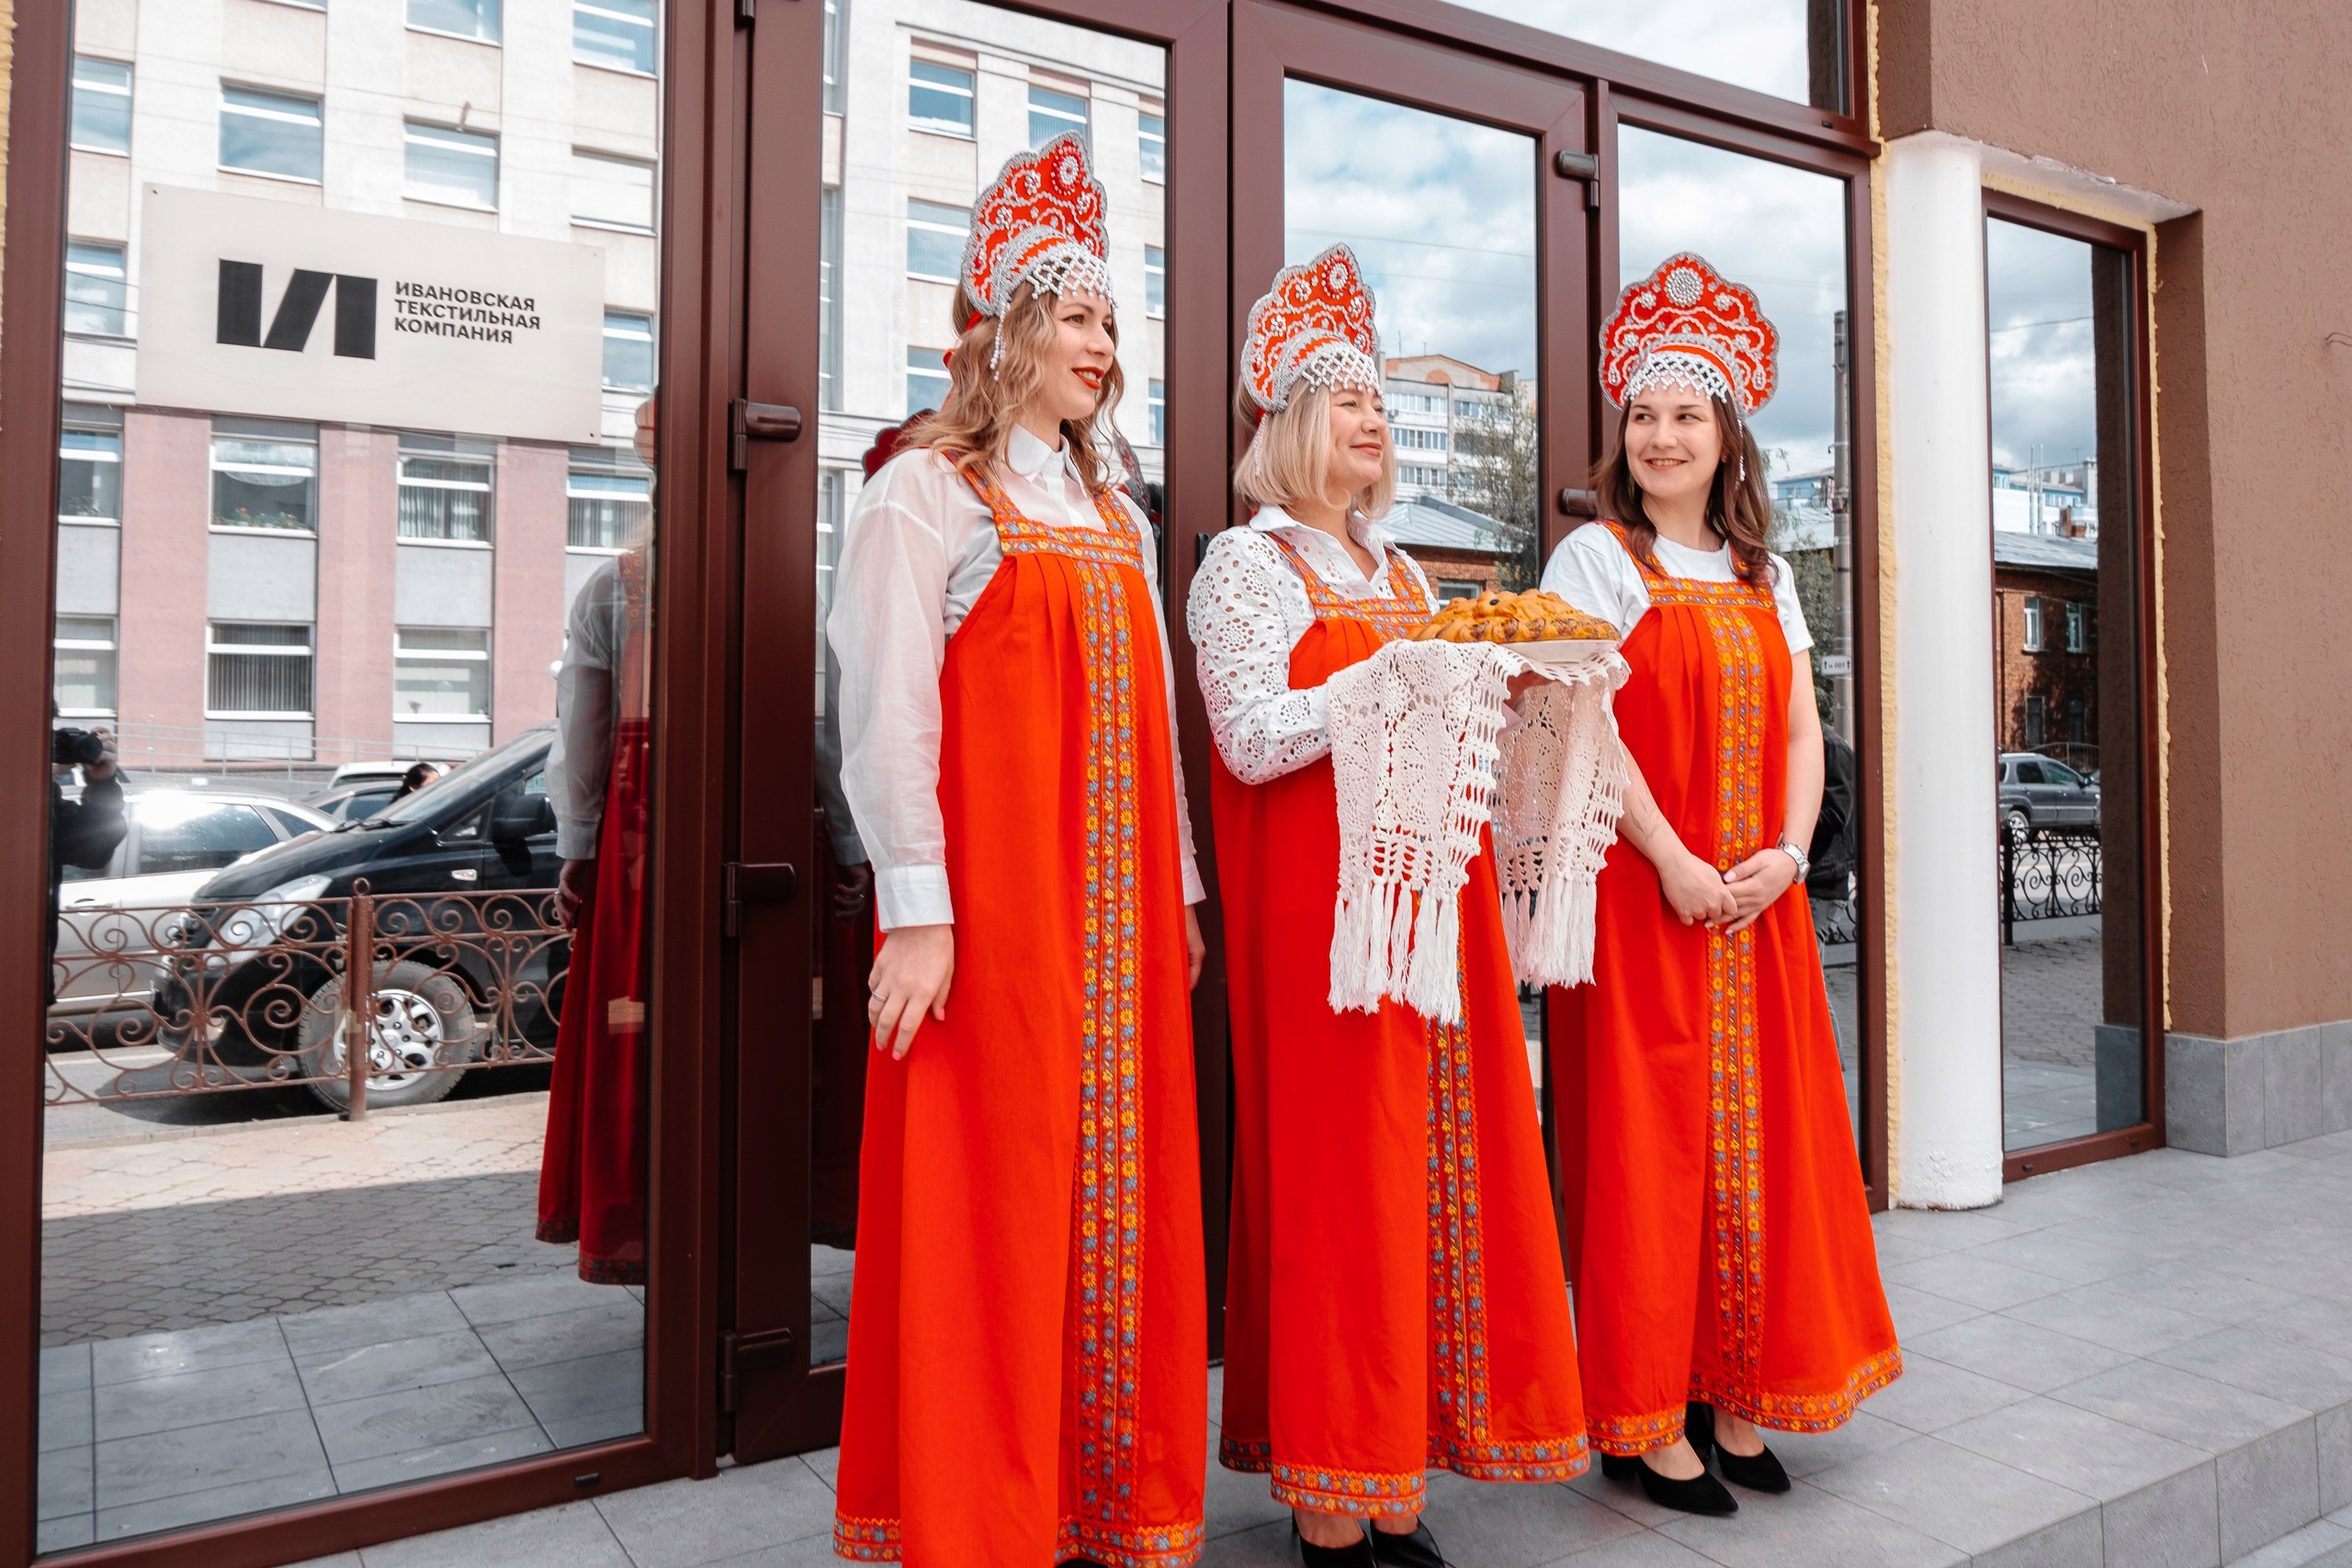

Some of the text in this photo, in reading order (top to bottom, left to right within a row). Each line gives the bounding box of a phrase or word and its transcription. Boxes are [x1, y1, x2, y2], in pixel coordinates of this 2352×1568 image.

[395, 280, 536, 311] ИВАНОВСКАЯ
[394, 299, 541, 330] ТЕКСТИЛЬНАЯ
[394, 316, 513, 344] КОМПАНИЯ
